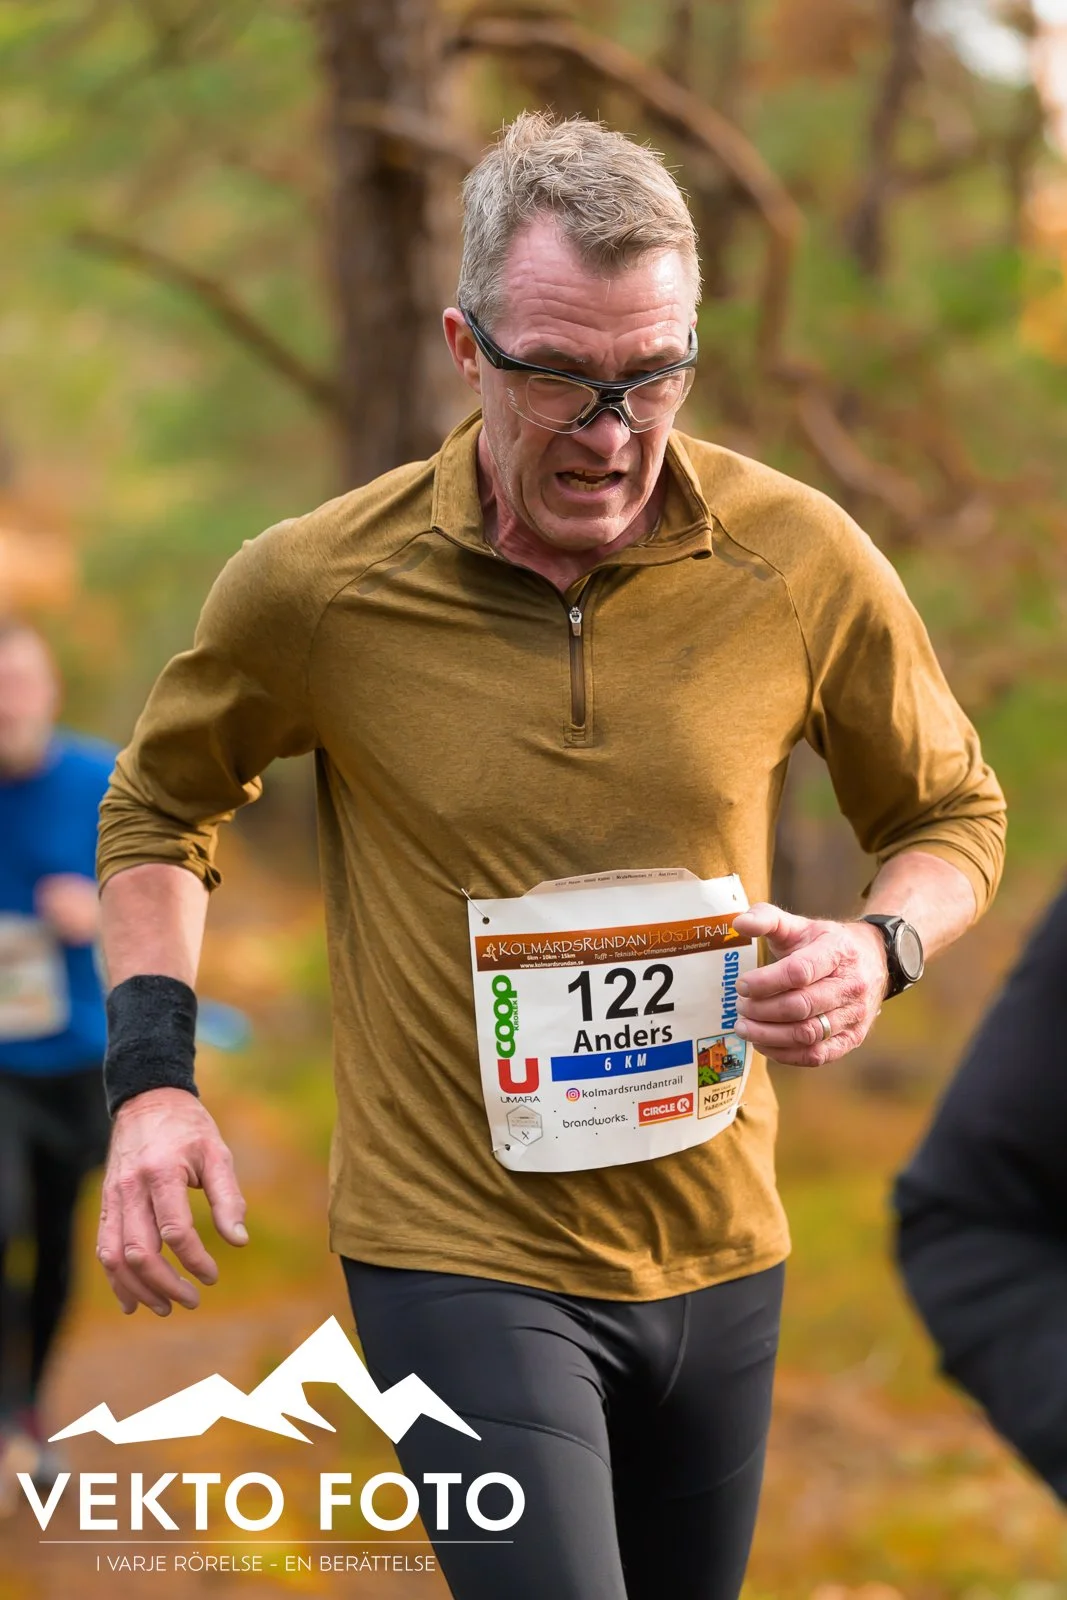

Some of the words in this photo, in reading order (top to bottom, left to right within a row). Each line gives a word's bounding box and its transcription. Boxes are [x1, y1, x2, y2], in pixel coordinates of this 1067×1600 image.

[693, 923, 731, 940] TRAIL
[568, 964, 675, 1022] 122
[721, 951, 740, 1030] Aktivitus
[492, 974, 518, 1058] coop
[573, 1024, 673, 1054] Anders
[604, 1057, 612, 1071] 6
[582, 1075, 684, 1098] kolmardsrundantrail
[704, 1086, 736, 1105] NØTTE
[500, 1096, 541, 1104] UMARA
[642, 1102, 676, 1117] CIRCLE
[562, 1114, 628, 1128] brandworks.
